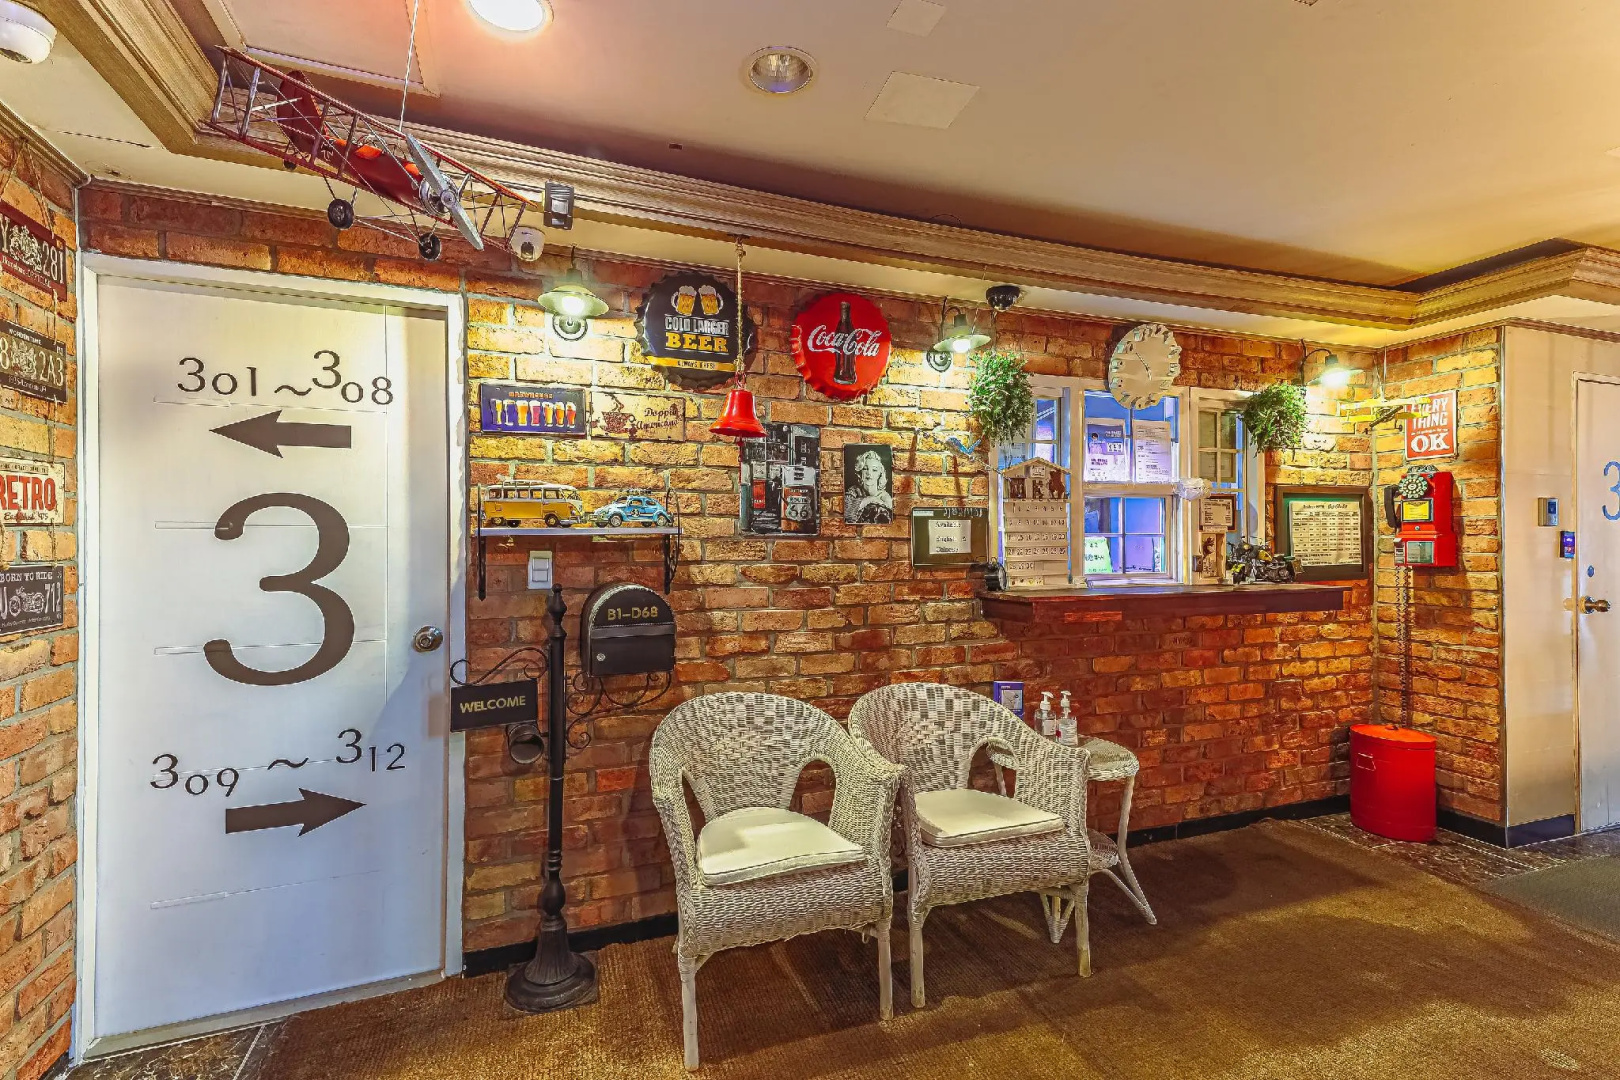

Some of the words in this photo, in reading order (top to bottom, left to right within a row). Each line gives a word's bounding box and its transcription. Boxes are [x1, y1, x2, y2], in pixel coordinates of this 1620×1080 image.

[42, 241, 64, 284] 281
[665, 332, 729, 353] BEER
[38, 350, 64, 388] 2A3
[1410, 432, 1451, 453] OK
[789, 503, 809, 519] 66
[0, 572, 22, 583] BORN
[24, 572, 34, 581] TO
[202, 491, 355, 687] 3
[607, 606, 658, 621] B1-D68
[459, 695, 526, 714] WELCOME
[149, 753, 240, 797] 309
[335, 728, 407, 773] 312
